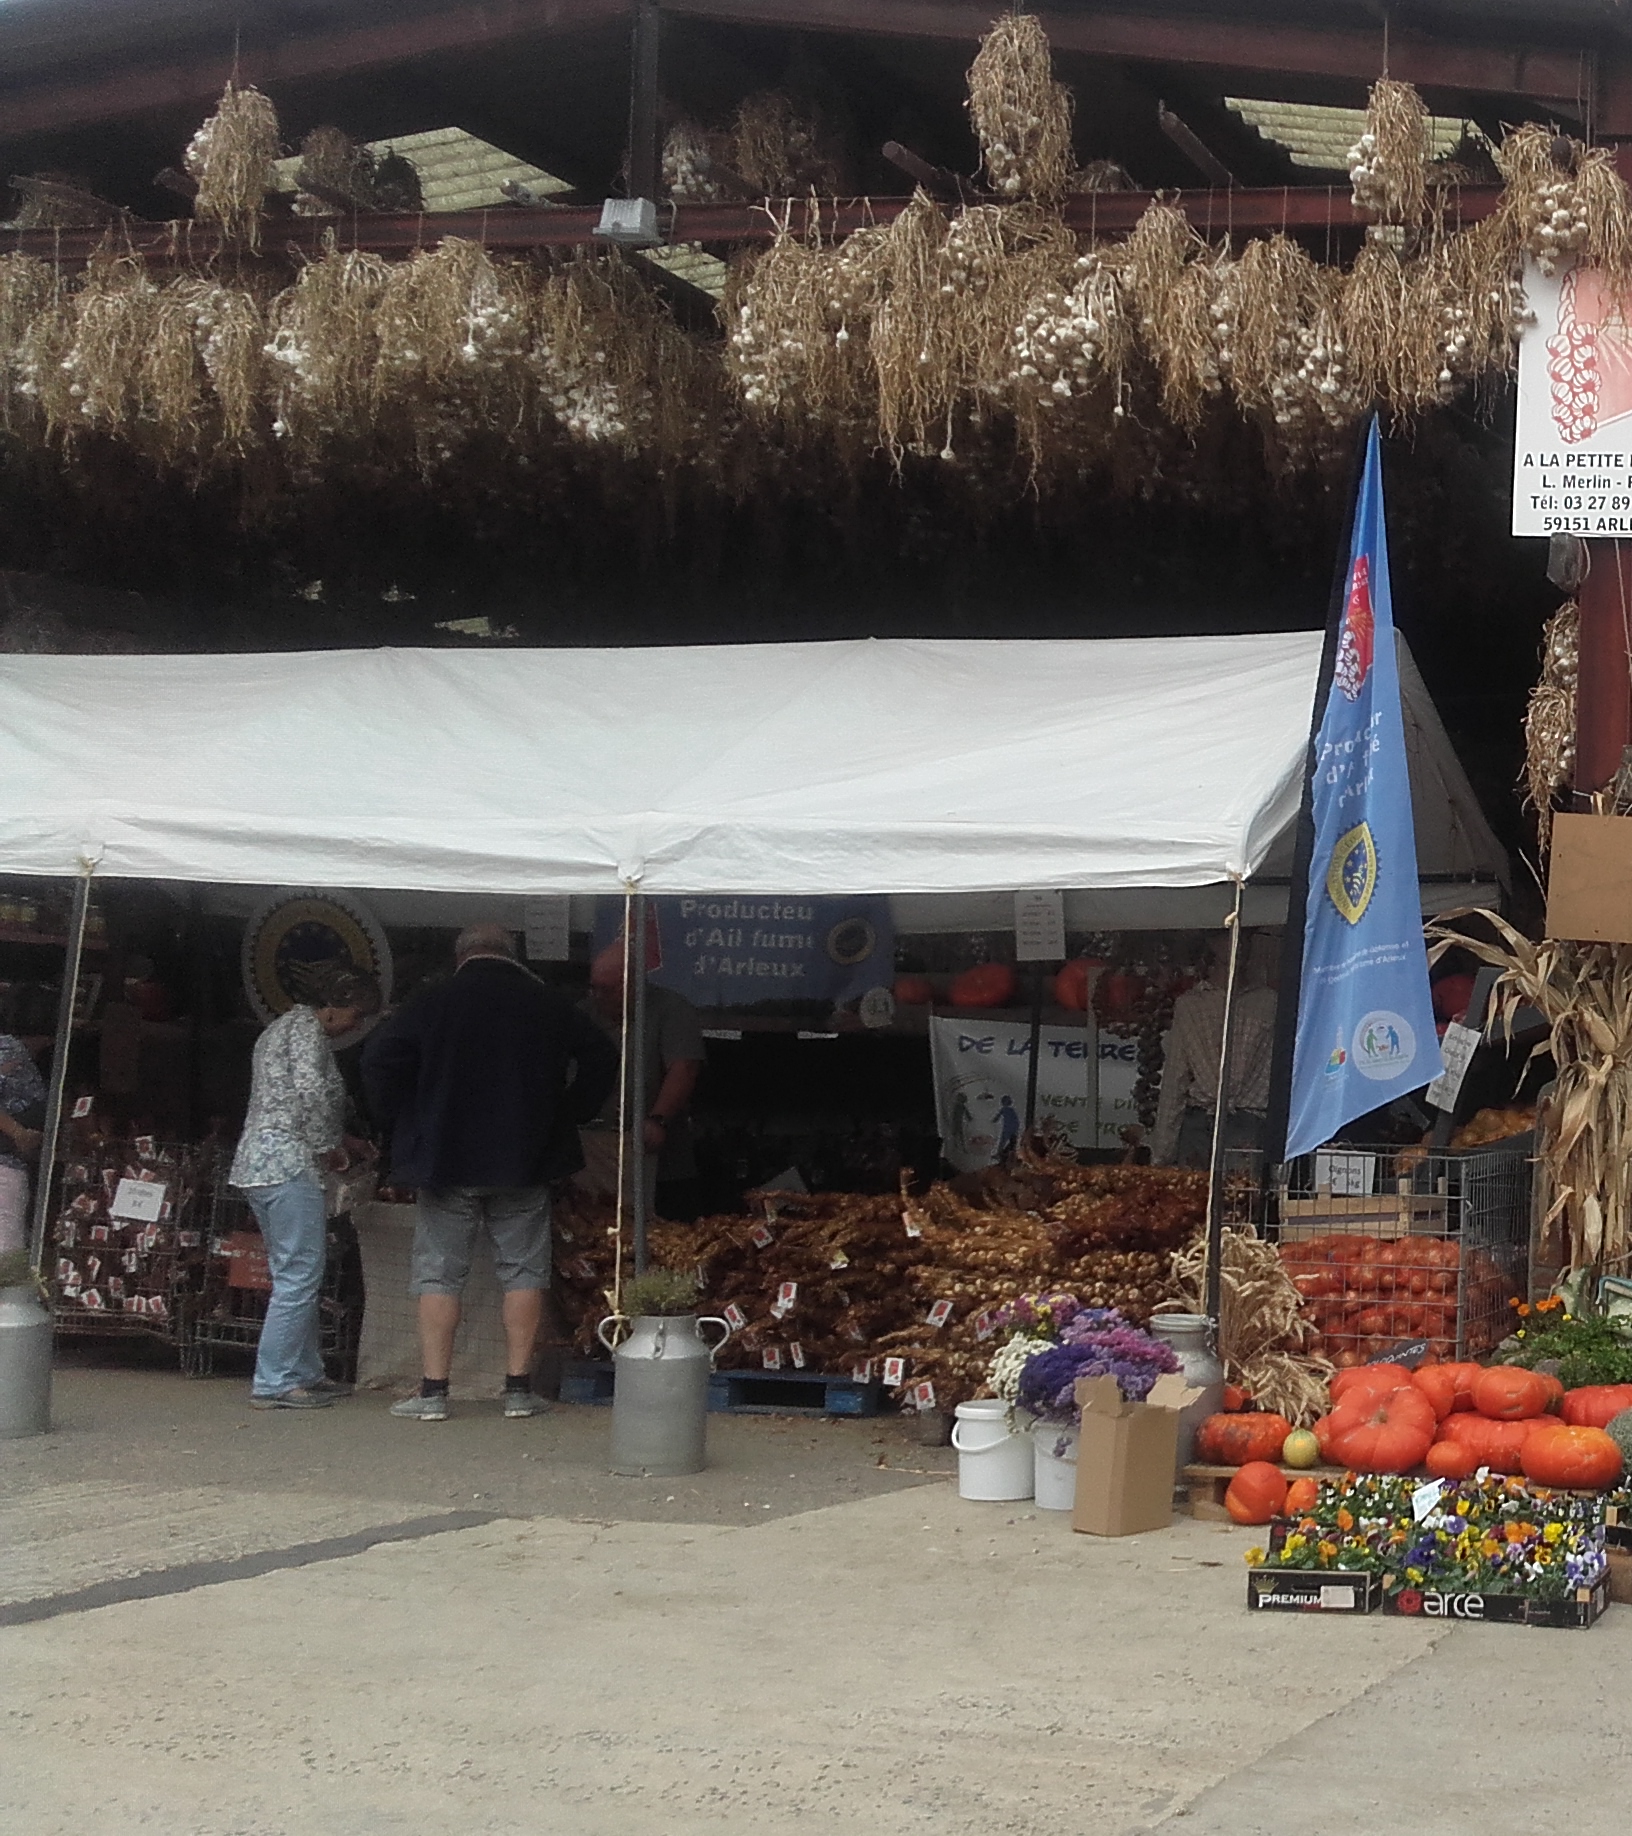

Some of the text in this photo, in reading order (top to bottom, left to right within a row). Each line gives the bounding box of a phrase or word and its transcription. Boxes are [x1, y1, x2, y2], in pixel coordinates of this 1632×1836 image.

[1523, 453, 1534, 467] A
[1540, 453, 1560, 467] LA
[1566, 453, 1624, 467] PETITE
[1542, 475, 1556, 489] L.
[1563, 475, 1611, 489] Merlin
[1530, 495, 1558, 510] Tél:
[1564, 497, 1582, 510] 03
[1588, 497, 1605, 510] 27
[1612, 497, 1630, 511] 89
[1543, 517, 1590, 531] 59151
[958, 1035, 996, 1055] DE
[1007, 1038, 1033, 1056] LA
[1258, 1593, 1322, 1608] PREMIUM
[1423, 1592, 1485, 1619] arce
